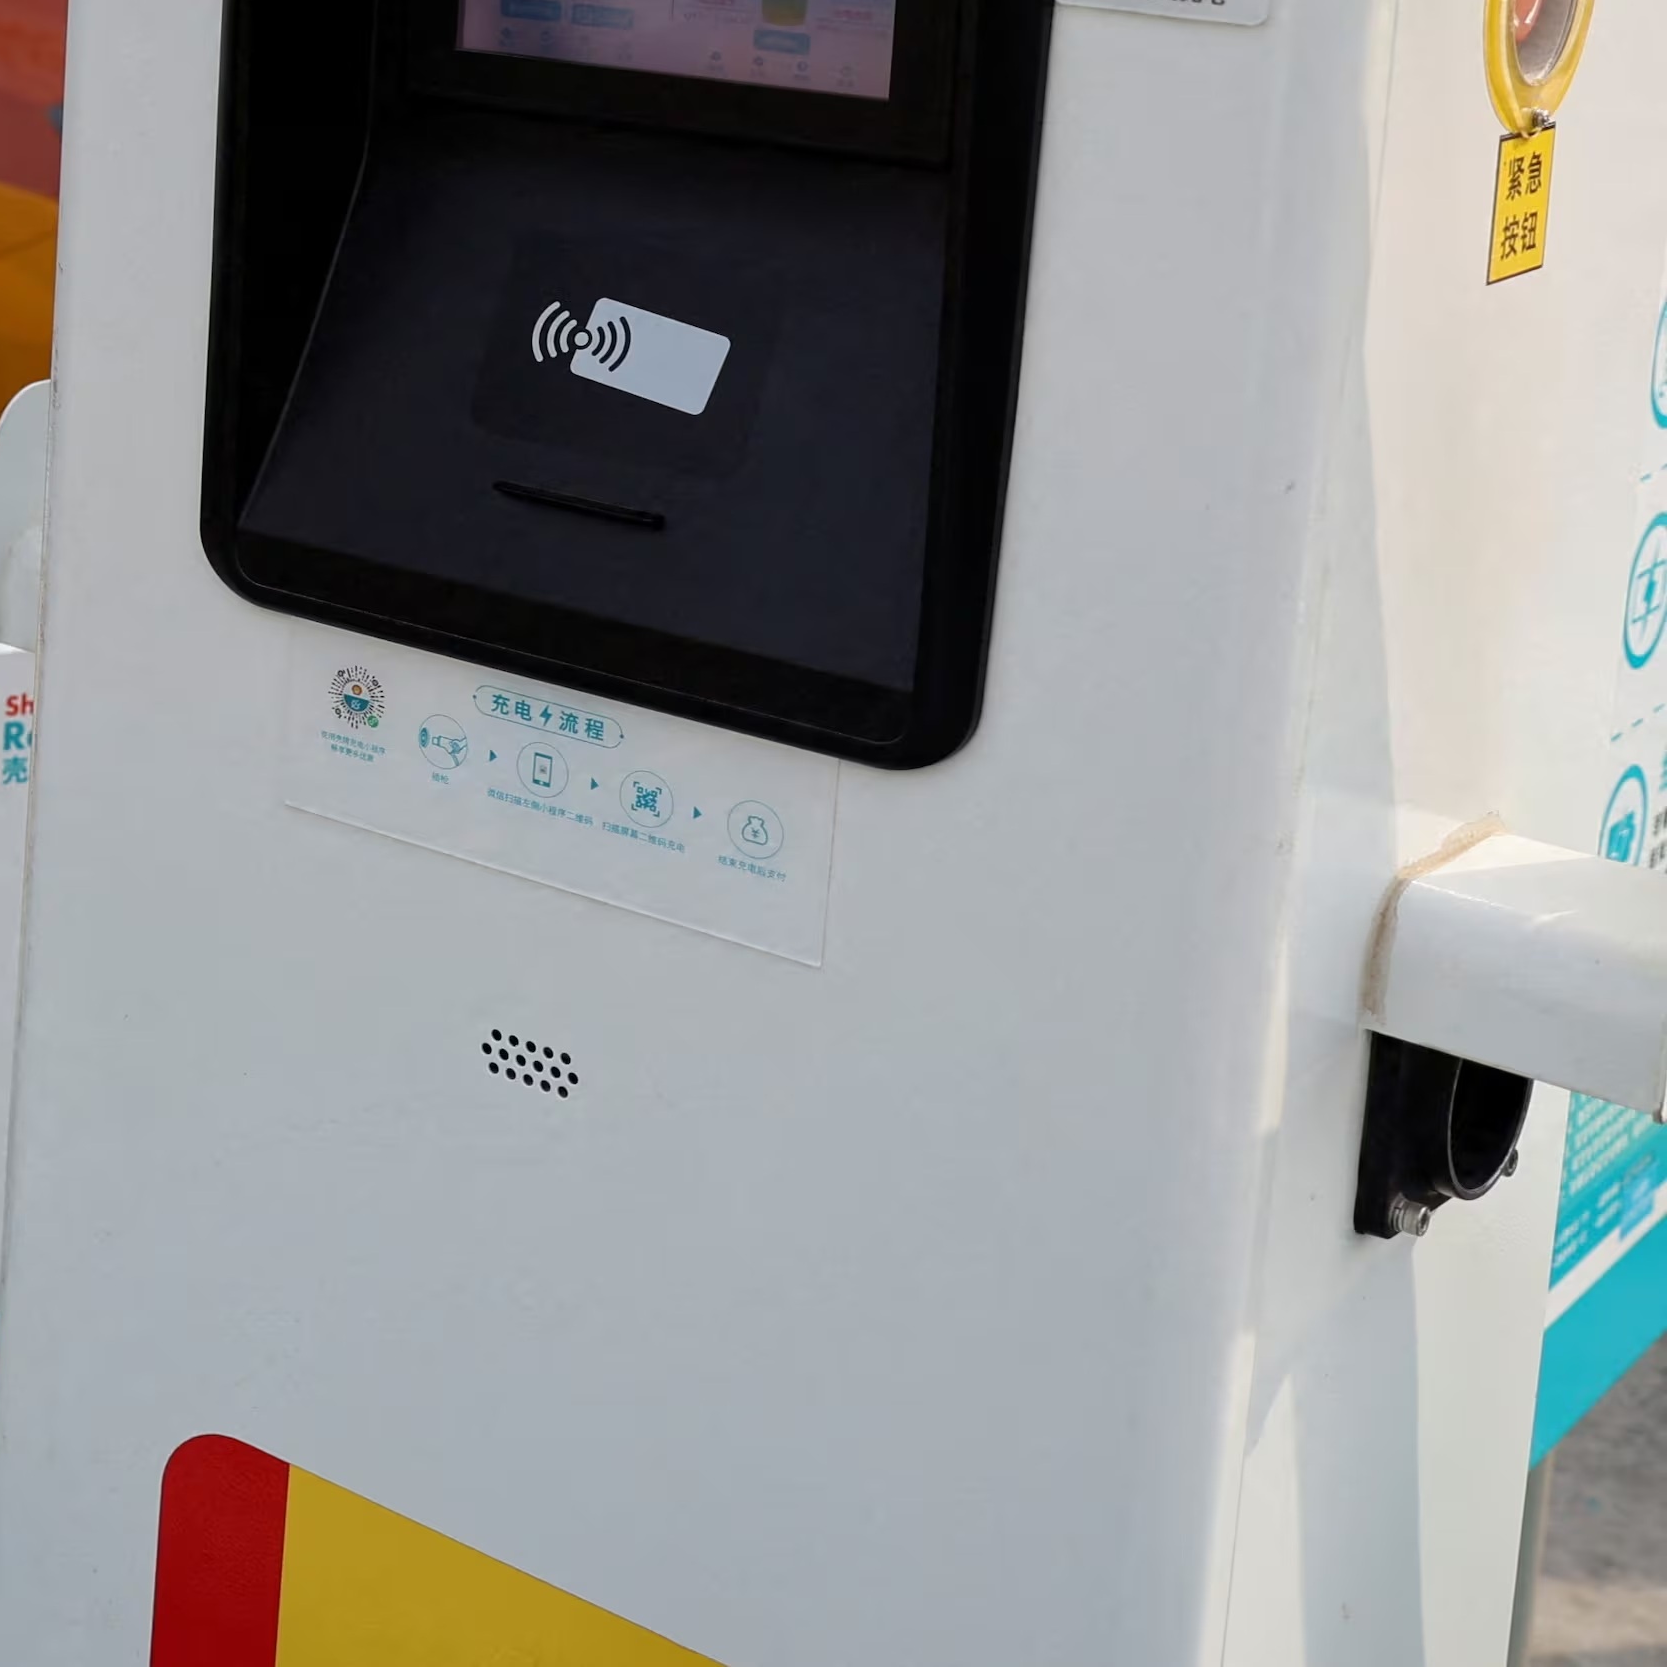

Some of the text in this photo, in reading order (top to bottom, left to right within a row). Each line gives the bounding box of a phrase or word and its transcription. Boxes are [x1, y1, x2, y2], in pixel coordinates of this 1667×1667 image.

[1505, 151, 1543, 201] 紧急
[1500, 210, 1538, 262] 按钮
[491, 694, 605, 742] 充电 流程
